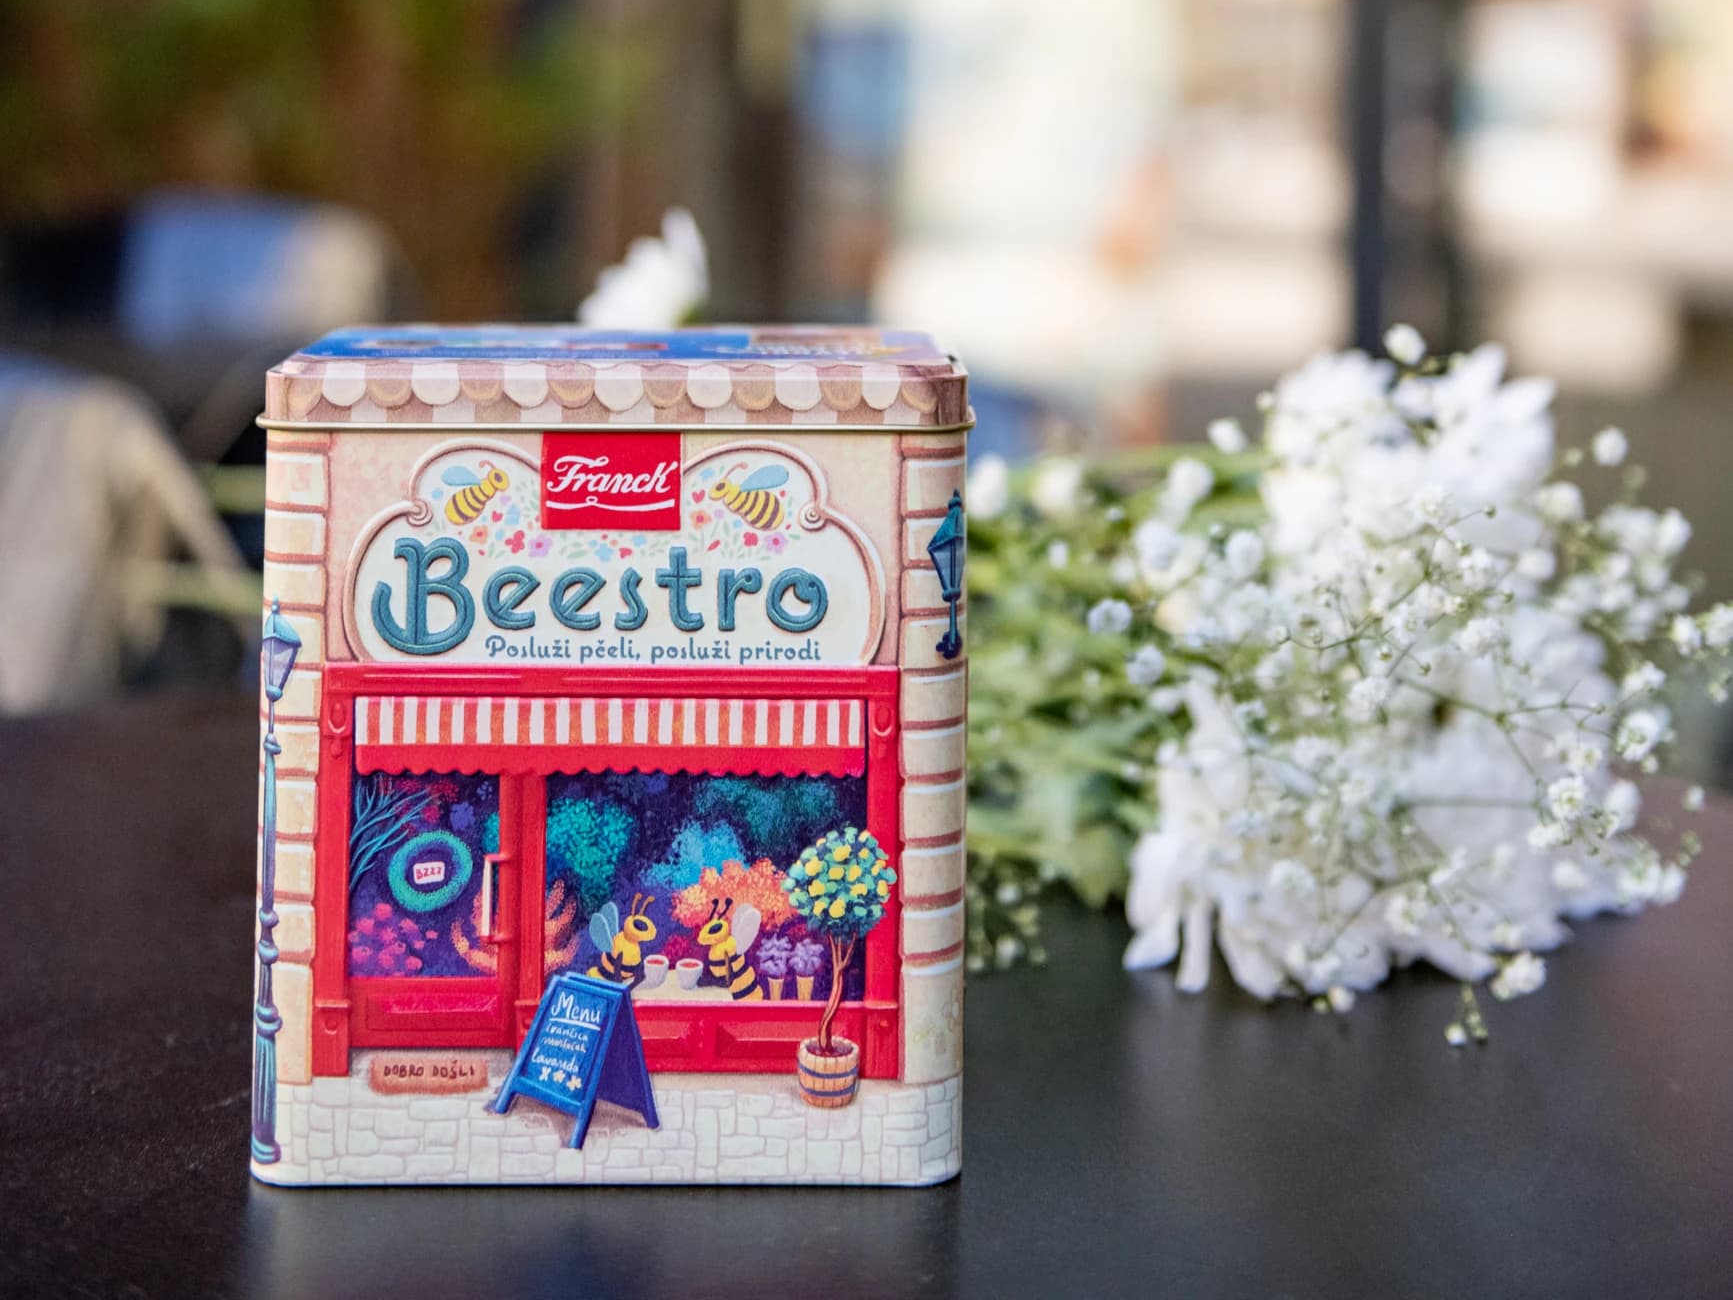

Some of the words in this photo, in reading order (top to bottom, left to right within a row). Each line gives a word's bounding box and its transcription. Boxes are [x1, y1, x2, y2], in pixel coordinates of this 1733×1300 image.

[546, 455, 679, 494] Franck
[371, 536, 829, 656] Beestro
[485, 635, 571, 659] Posluži
[580, 638, 641, 663] pčeli,
[651, 637, 731, 663] posluži
[739, 639, 821, 665] prirodi
[384, 1064, 424, 1078] DOBRO
[432, 1060, 475, 1079] DOŠLI
